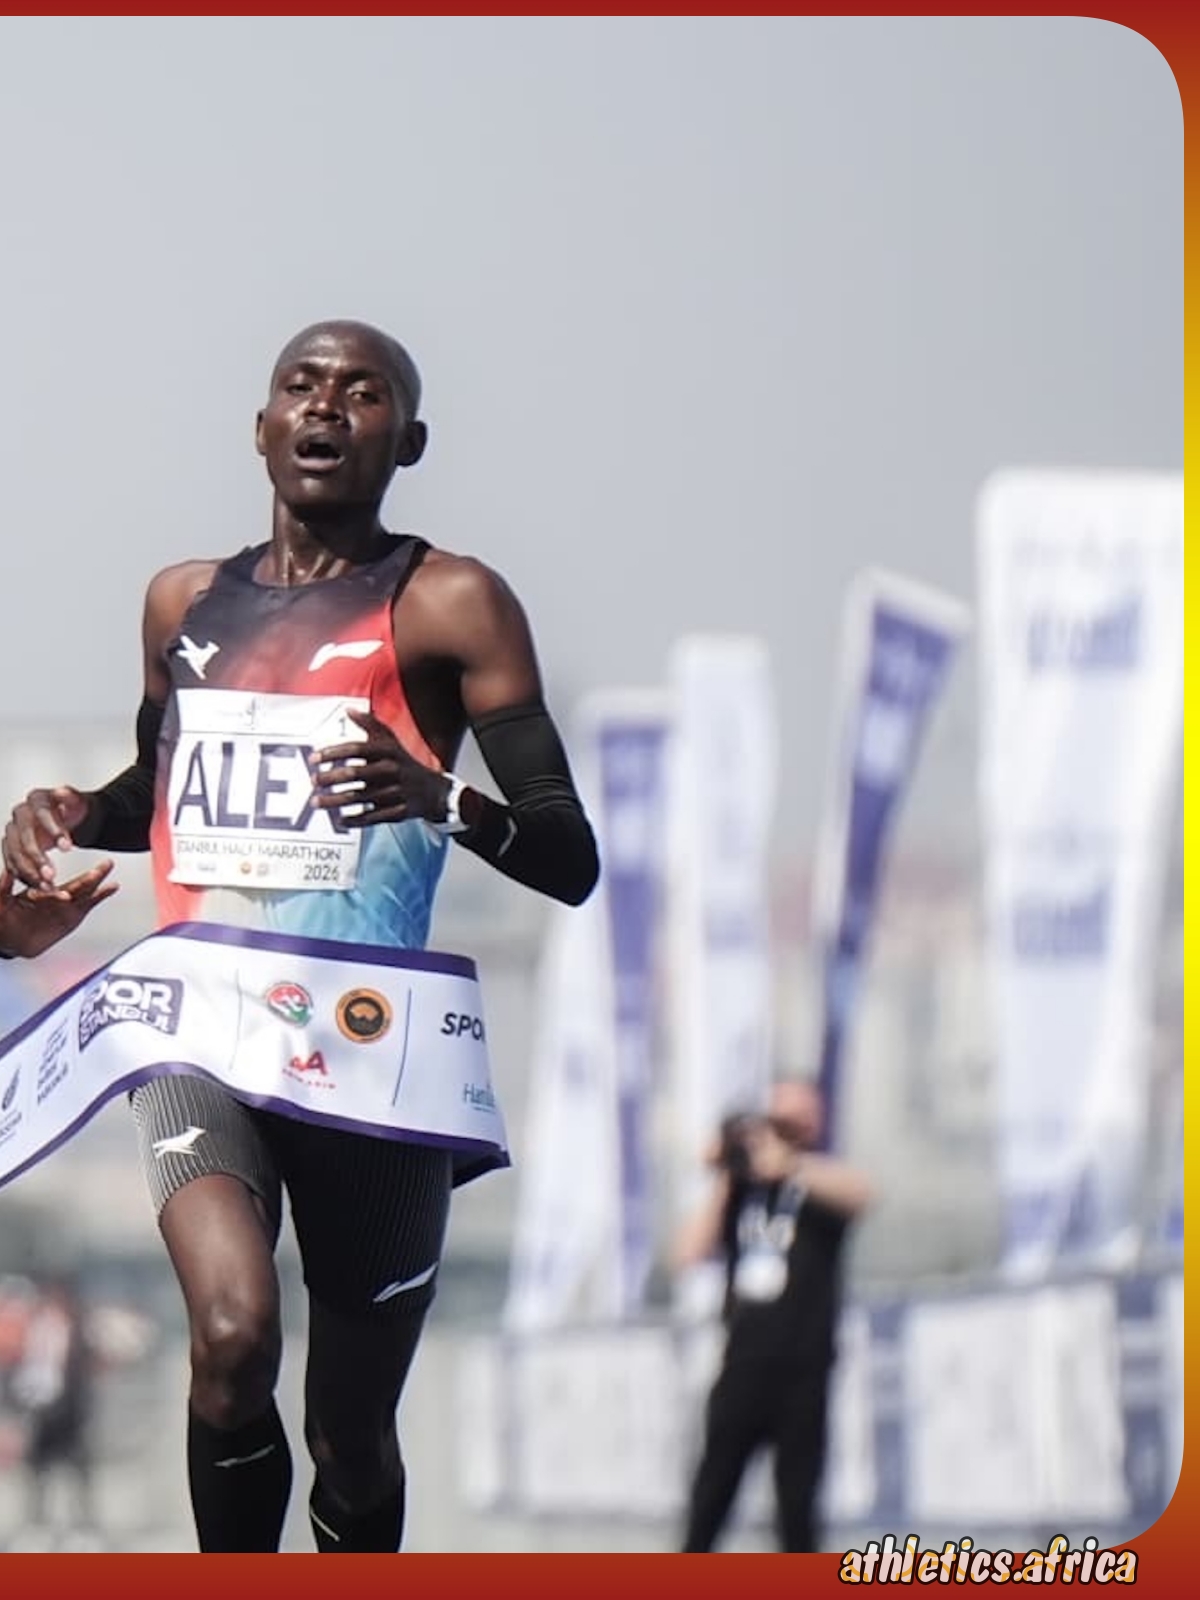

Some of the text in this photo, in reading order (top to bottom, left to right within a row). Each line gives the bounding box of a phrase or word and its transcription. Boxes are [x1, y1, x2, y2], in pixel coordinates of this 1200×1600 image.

[337, 715, 347, 737] 1
[174, 740, 350, 835] ALEX
[257, 844, 342, 861] MARATHON
[303, 864, 341, 882] 2026
[440, 1011, 486, 1044] SPO
